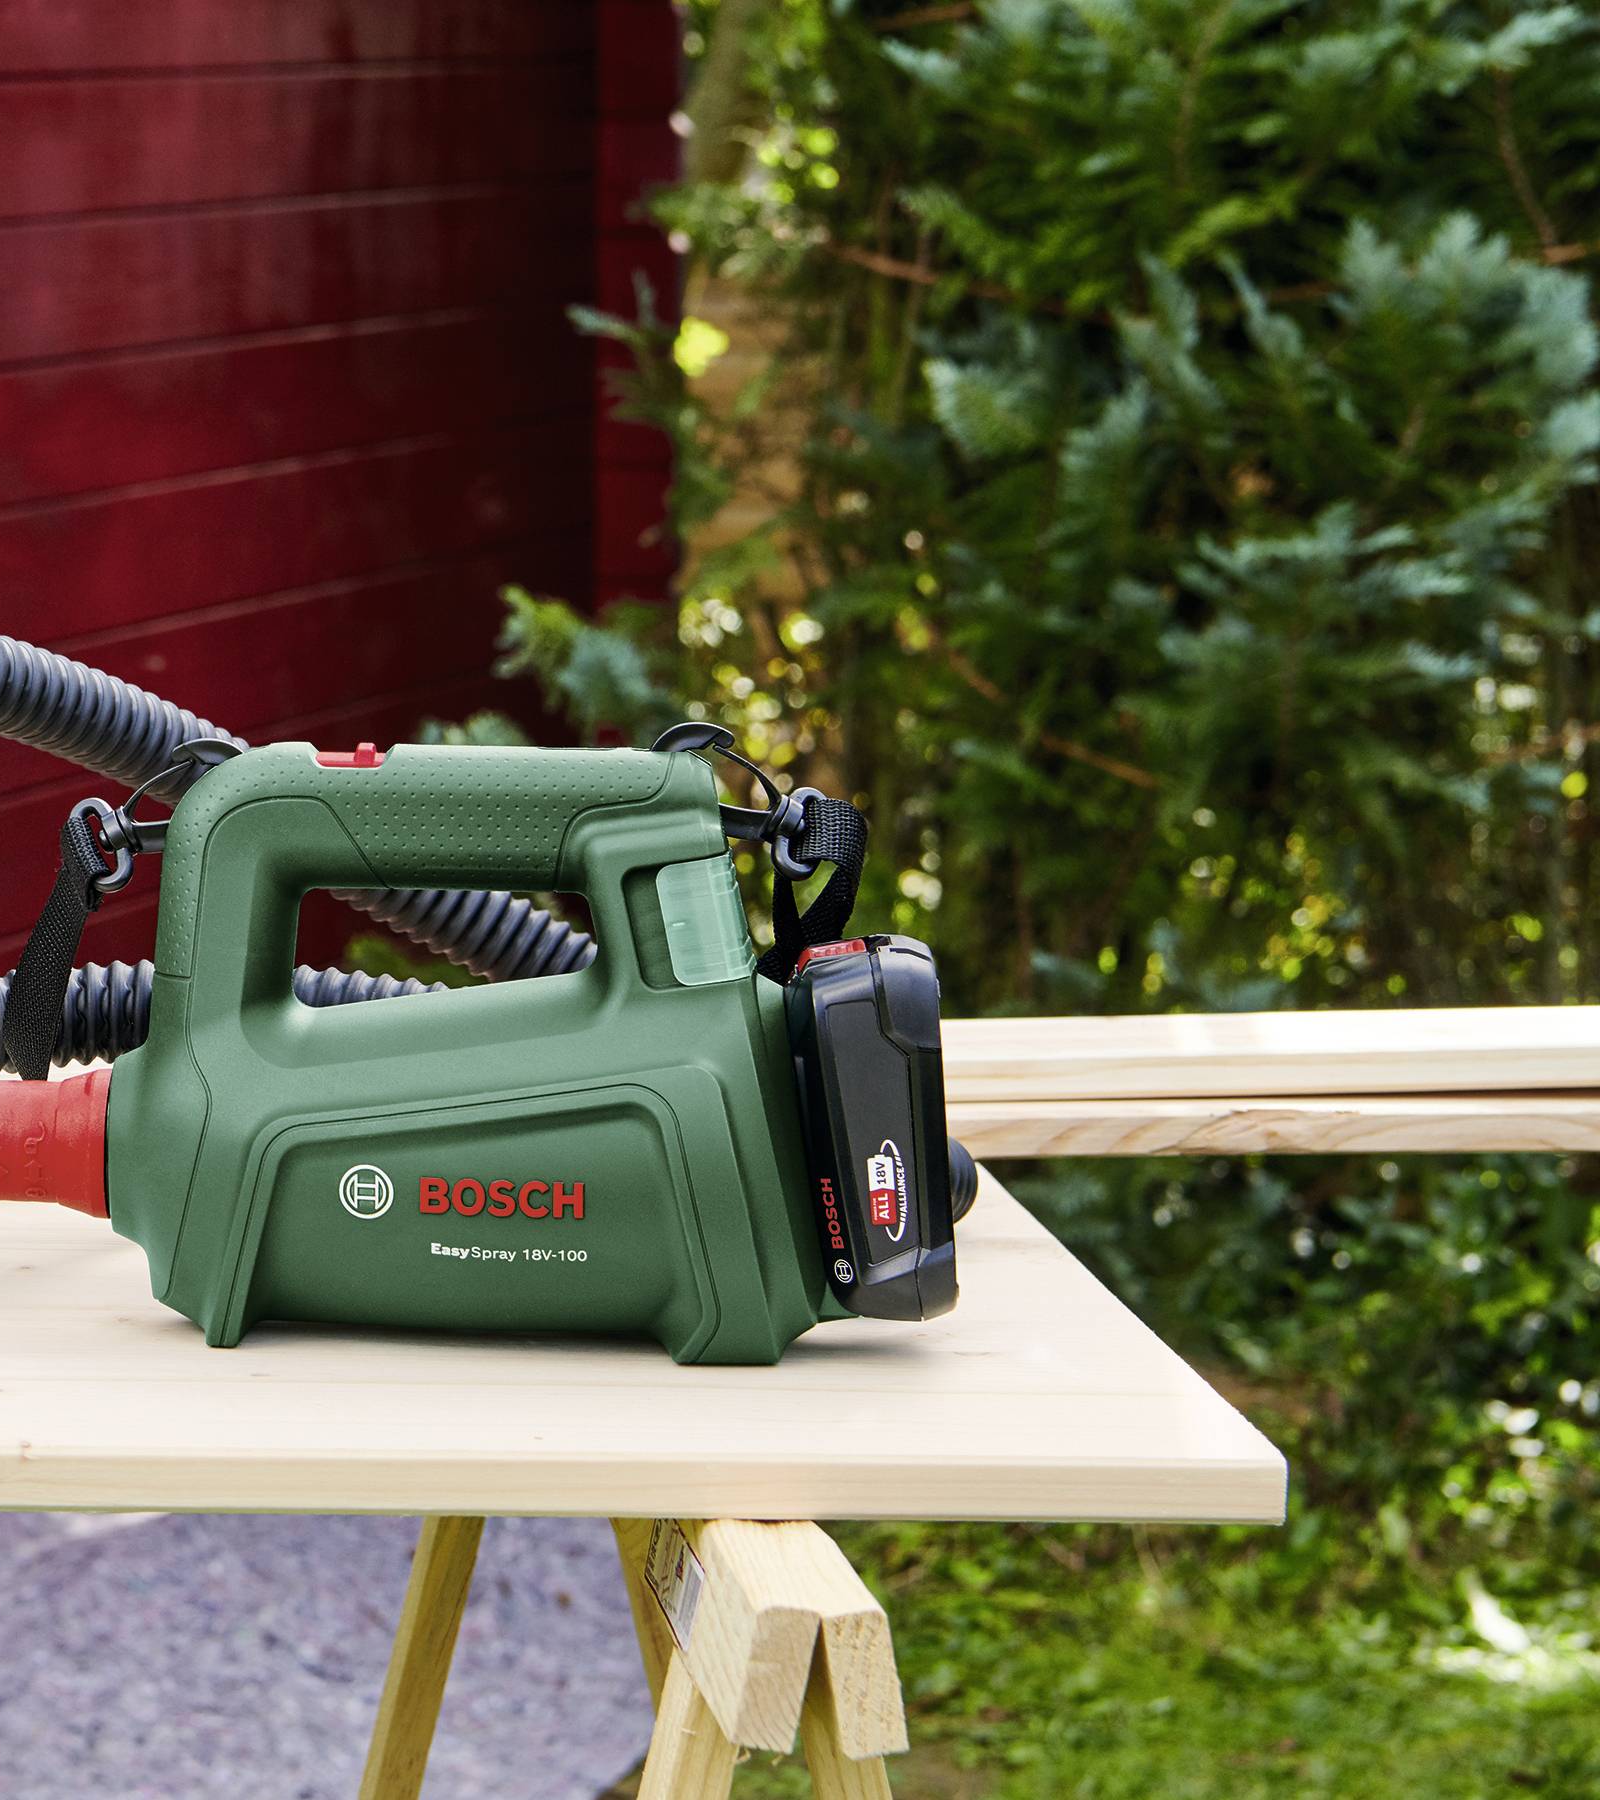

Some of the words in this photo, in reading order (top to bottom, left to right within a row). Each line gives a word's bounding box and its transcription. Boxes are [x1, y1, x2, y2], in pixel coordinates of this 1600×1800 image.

[875, 1162, 887, 1185] 18V
[896, 1167, 907, 1213] ALLIANCE
[419, 1177, 585, 1219] BOSCH
[820, 1178, 845, 1249] BOSCH
[878, 1193, 890, 1219] ALL
[430, 1242, 517, 1262] EasySpray
[522, 1248, 588, 1262] 18V-100
